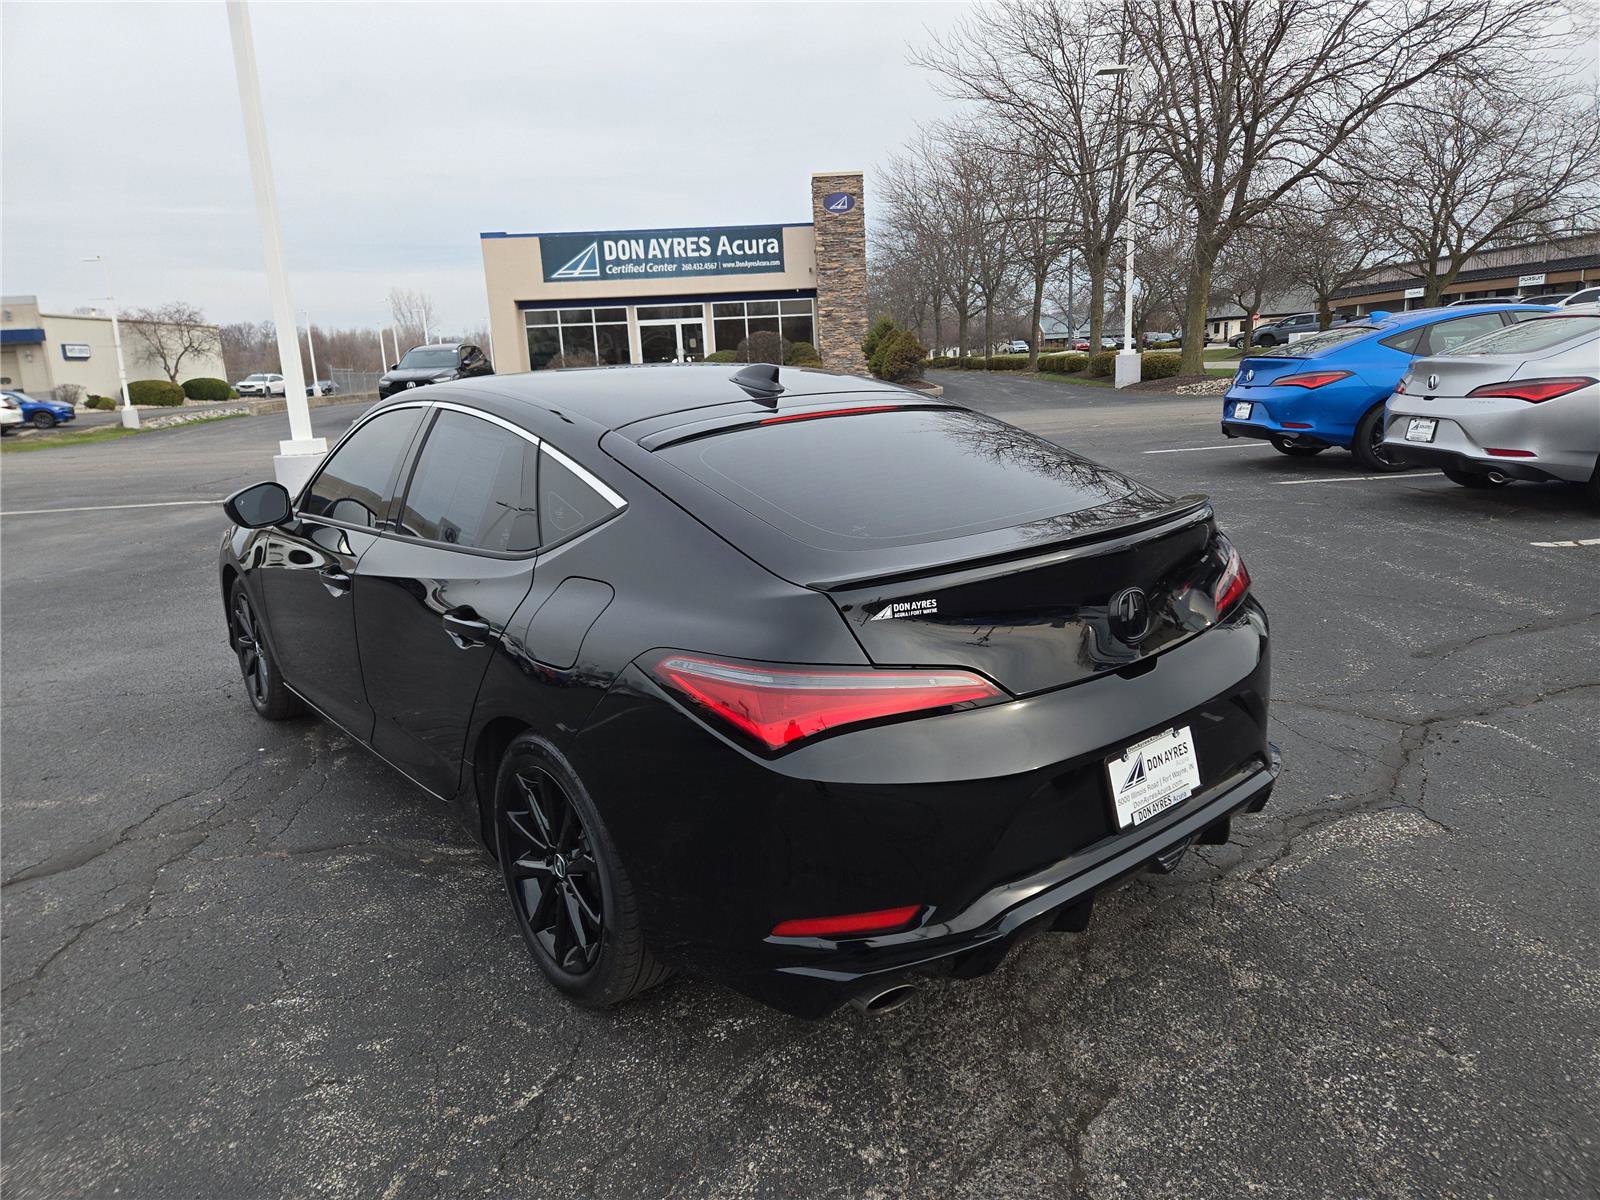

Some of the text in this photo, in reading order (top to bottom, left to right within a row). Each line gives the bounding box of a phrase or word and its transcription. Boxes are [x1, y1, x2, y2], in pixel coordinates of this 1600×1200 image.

[603, 235, 779, 261] DON AYRES Acura
[605, 262, 678, 274] Certified Center
[893, 599, 937, 612] DON AYRES
[1146, 741, 1189, 772] DON AYRES
[1138, 791, 1187, 821] DON AYRES Acura
